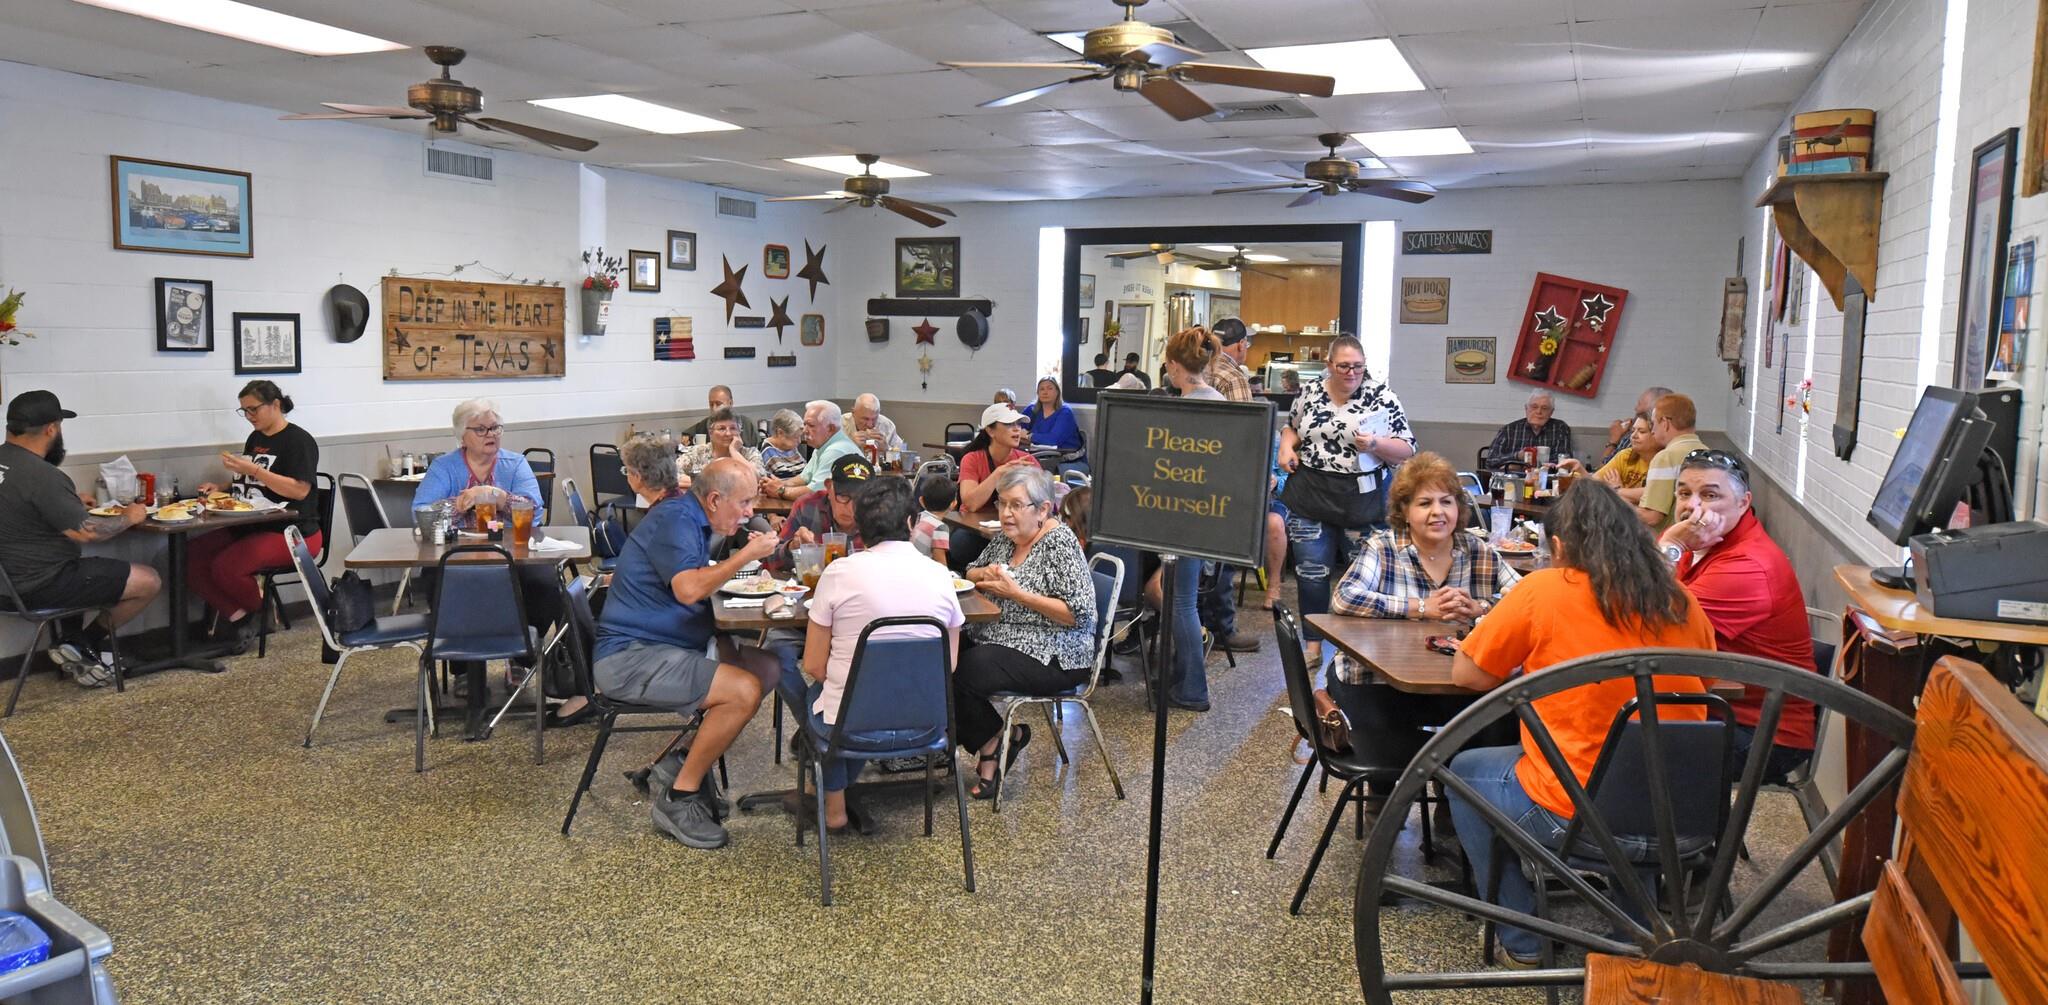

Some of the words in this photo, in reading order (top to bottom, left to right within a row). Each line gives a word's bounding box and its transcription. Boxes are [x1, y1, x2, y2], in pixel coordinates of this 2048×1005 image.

[1404, 281, 1423, 297] HOT
[1424, 281, 1446, 297] DOGS
[400, 286, 444, 323] DEEP
[452, 300, 467, 323] IN
[473, 301, 497, 323] THE
[504, 292, 554, 327] HEART
[413, 346, 441, 372] OF
[456, 334, 530, 372] TEXAS
[1448, 340, 1494, 355] HAMBURGERS
[1145, 427, 1223, 455] Please
[1153, 457, 1207, 484] Seat
[1131, 485, 1231, 518] Yourself
